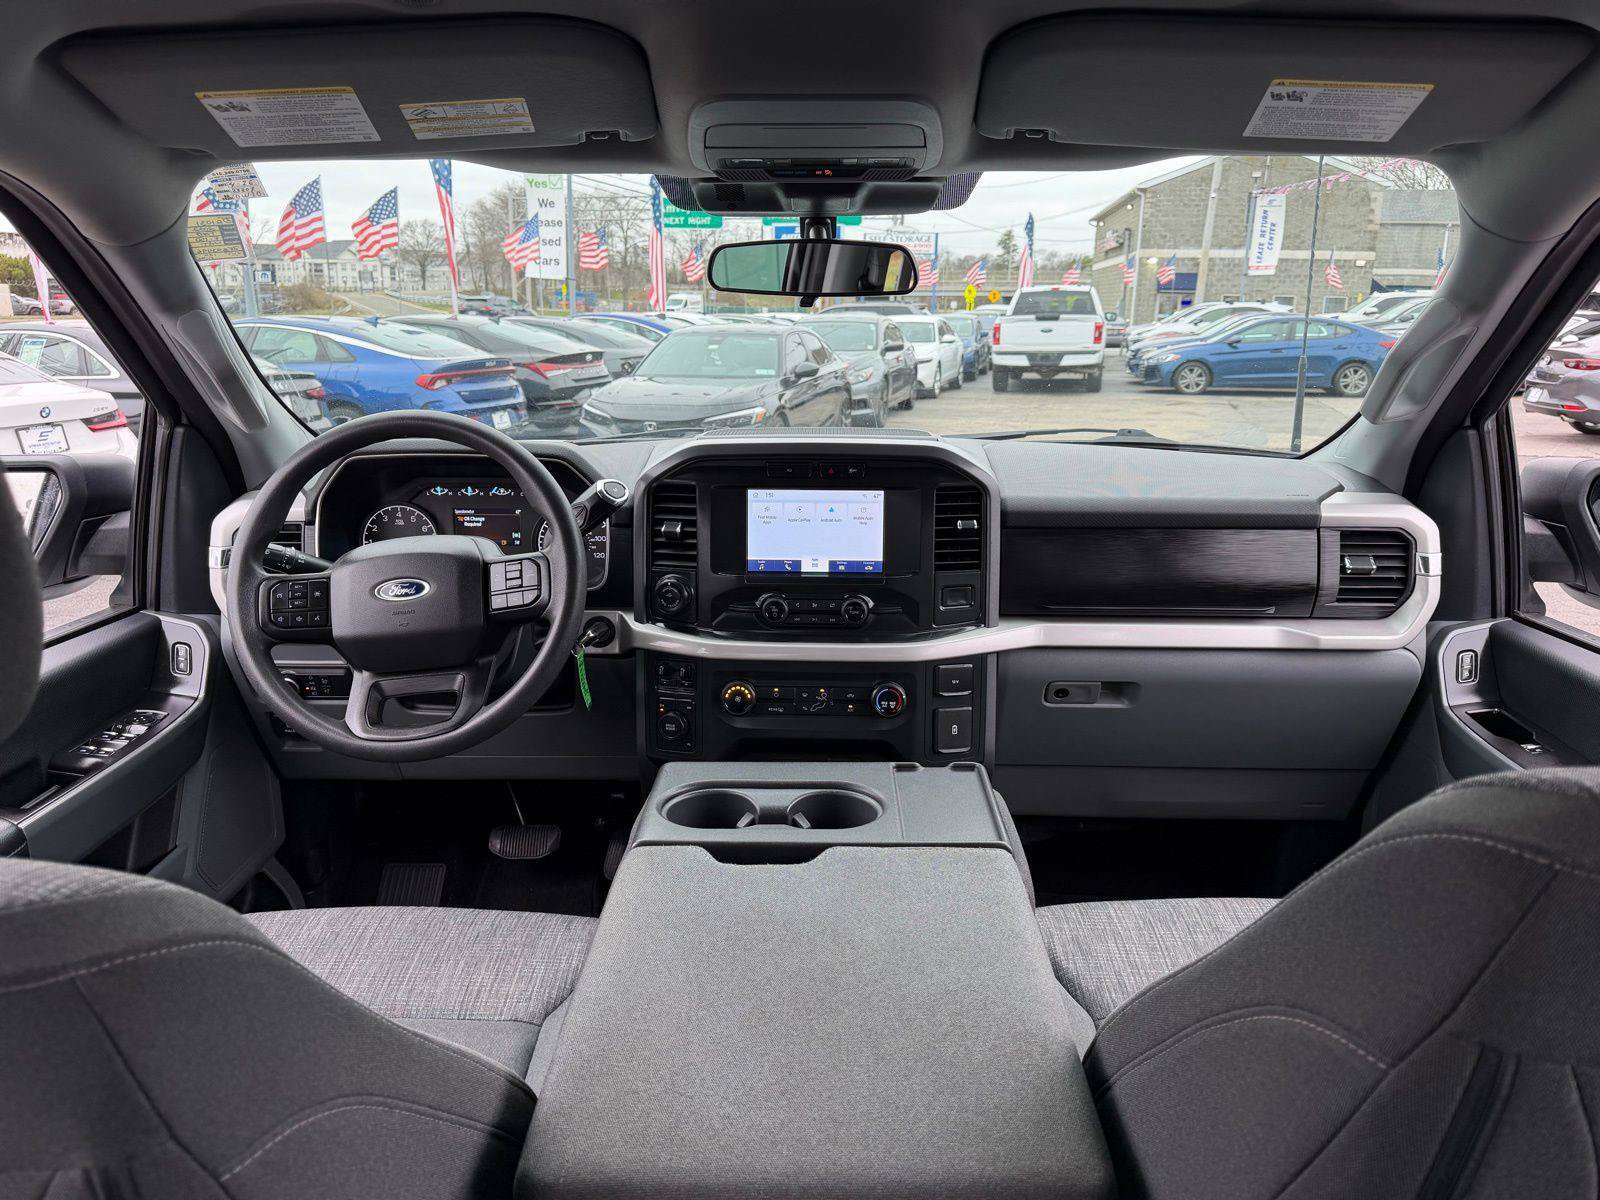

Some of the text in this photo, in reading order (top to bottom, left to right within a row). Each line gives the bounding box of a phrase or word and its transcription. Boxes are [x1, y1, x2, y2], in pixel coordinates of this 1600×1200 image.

[527, 178, 548, 189] Yes
[538, 198, 555, 208] We
[539, 219, 563, 228] ease
[663, 217, 711, 225] NEXT RIGHT
[888, 235, 932, 243] STORAGE
[1256, 209, 1269, 264] LEASE RETURN
[1267, 222, 1276, 251] CENTER
[541, 237, 561, 247] sed
[388, 583, 416, 596] Ford
